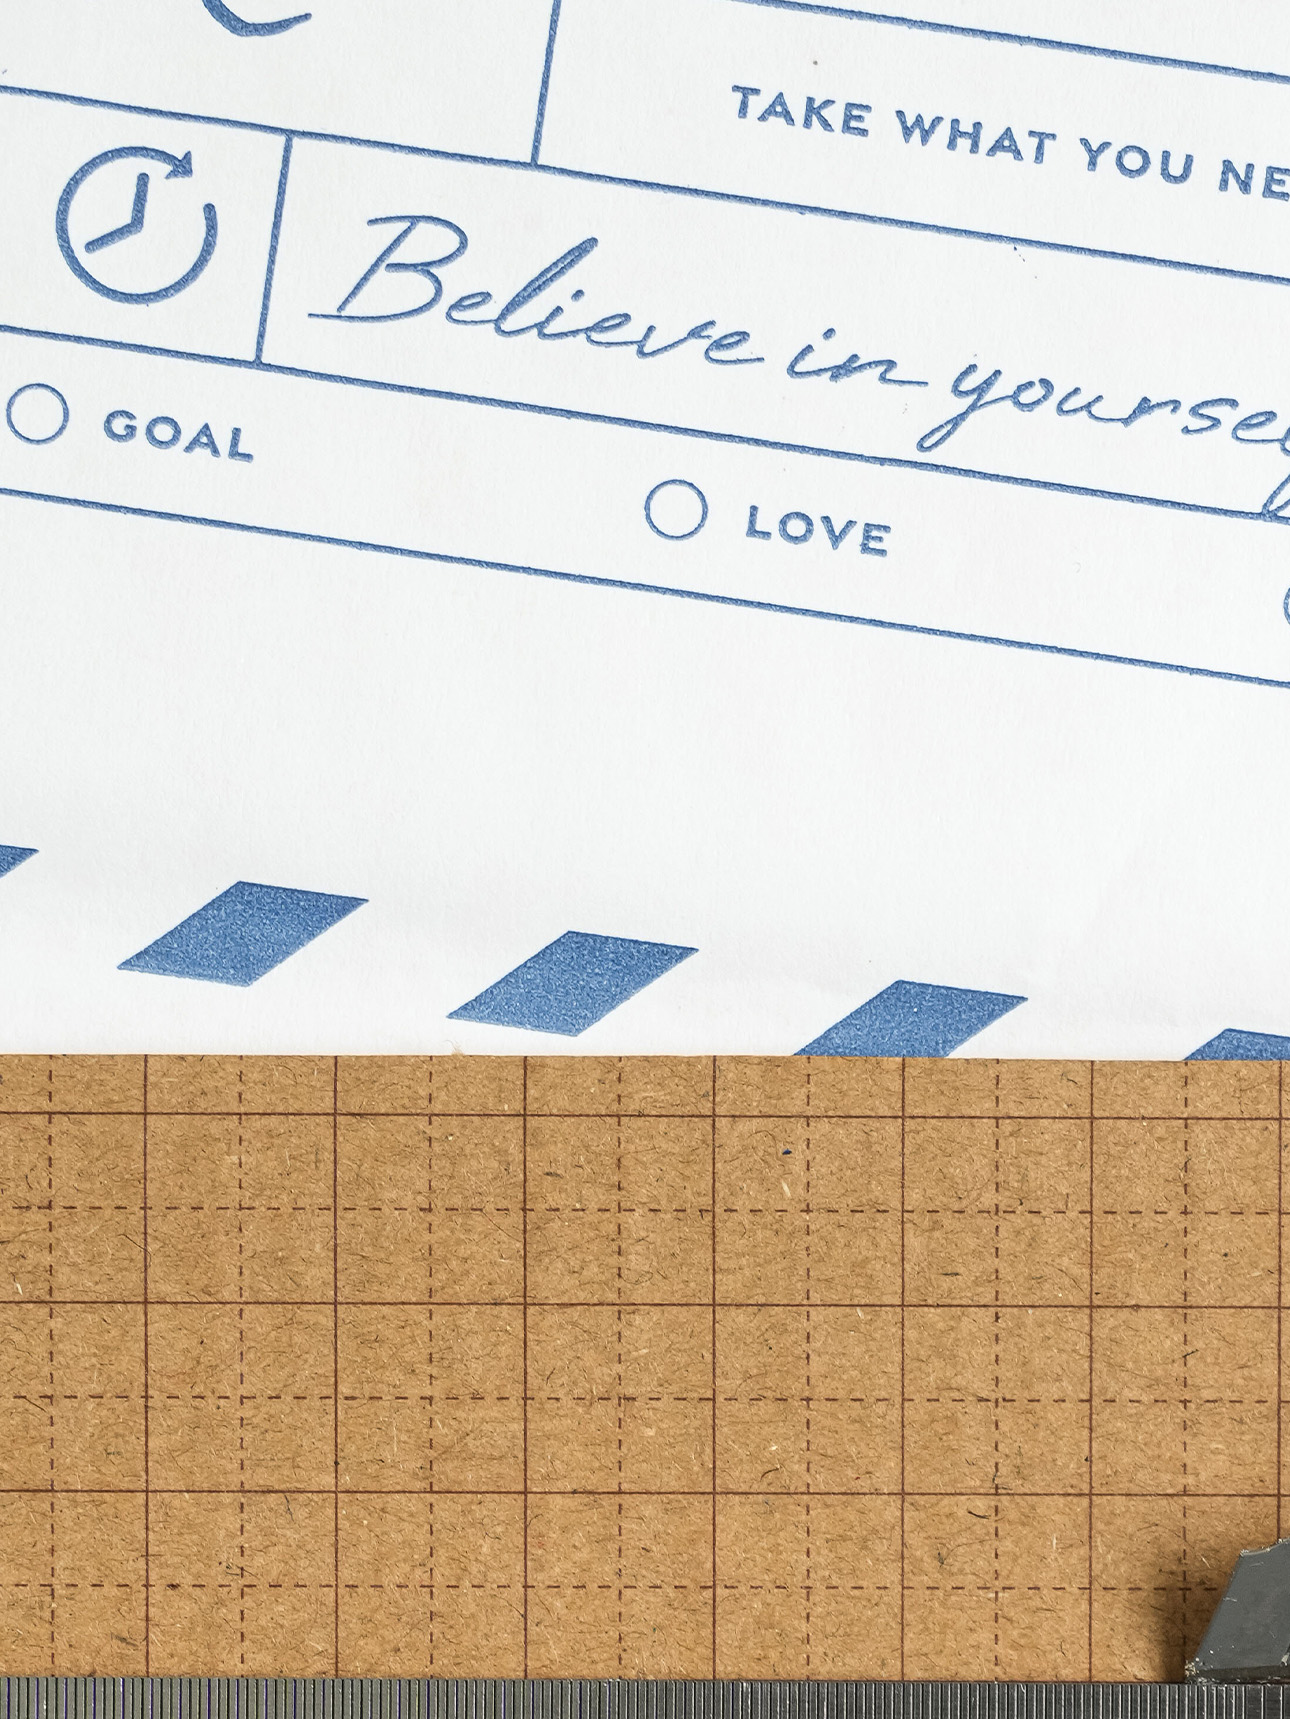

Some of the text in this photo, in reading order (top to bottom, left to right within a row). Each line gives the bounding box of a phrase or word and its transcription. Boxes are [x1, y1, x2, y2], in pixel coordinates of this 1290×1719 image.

[732, 85, 872, 136] TAKE
[896, 110, 1056, 164] WHAT
[1080, 138, 1194, 184] YOU
[308, 215, 764, 364] Believe
[787, 328, 928, 386] in
[104, 410, 253, 462] GOAL
[746, 505, 890, 556] LOVE
